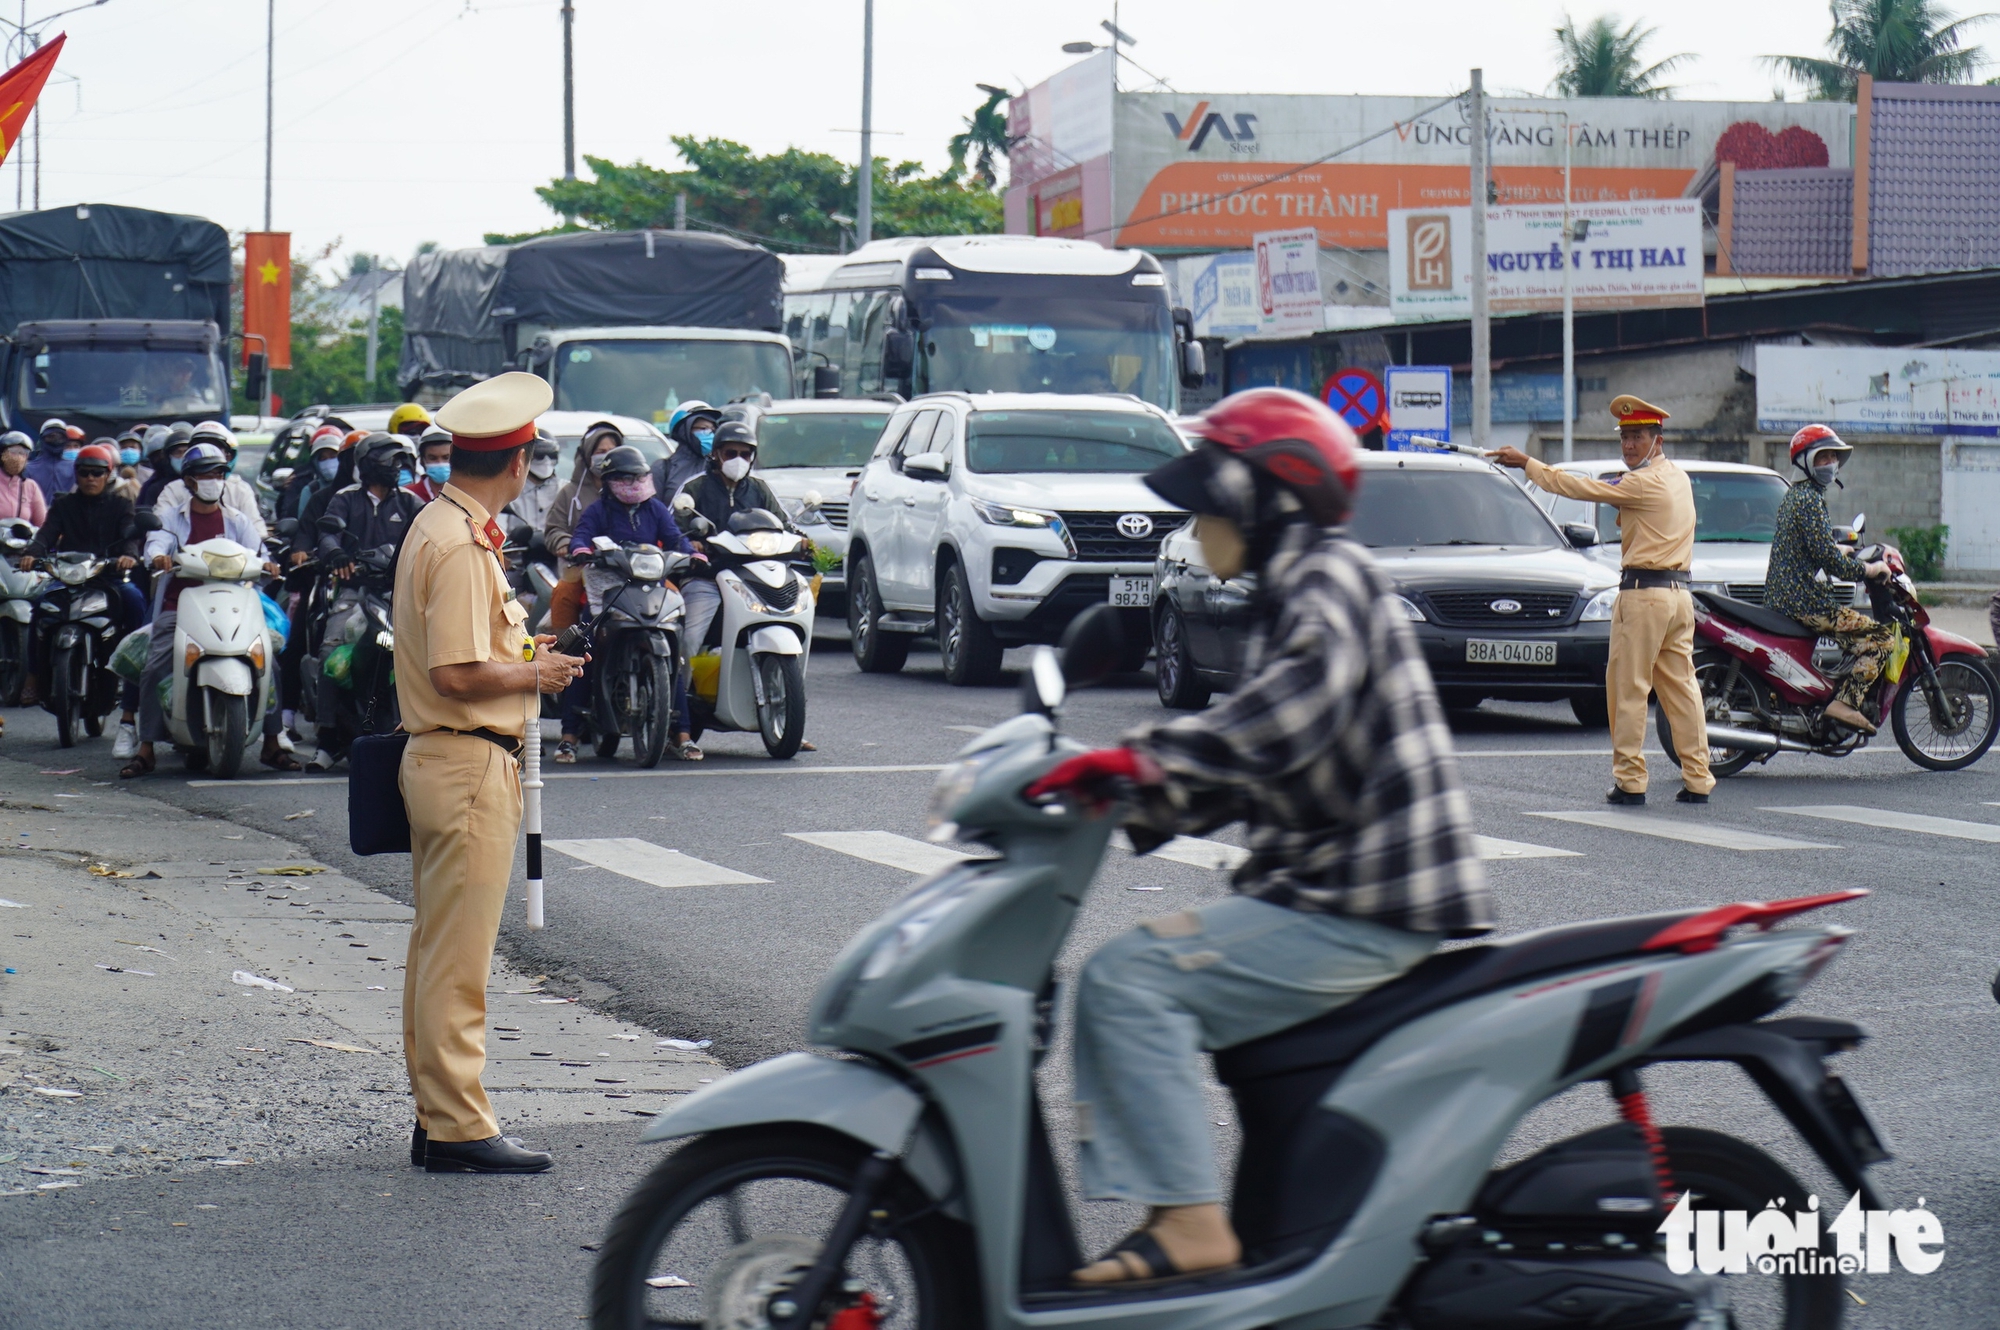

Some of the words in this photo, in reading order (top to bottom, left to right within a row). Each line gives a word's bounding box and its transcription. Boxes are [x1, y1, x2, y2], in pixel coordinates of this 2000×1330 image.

[1561, 122, 1617, 148] TÂM
[1624, 121, 1691, 149] THÉP
[1229, 141, 1260, 154] Steel
[1160, 187, 1268, 218] PHƯỚC
[1276, 188, 1379, 218] THÀNH
[1591, 248, 1633, 272] THỊ
[1639, 247, 1687, 267] HAI
[1901, 409, 1926, 422] cung
[1124, 580, 1149, 592] 51H
[1114, 593, 1150, 605] 982.9
[1468, 643, 1554, 662] 38A-040.68
